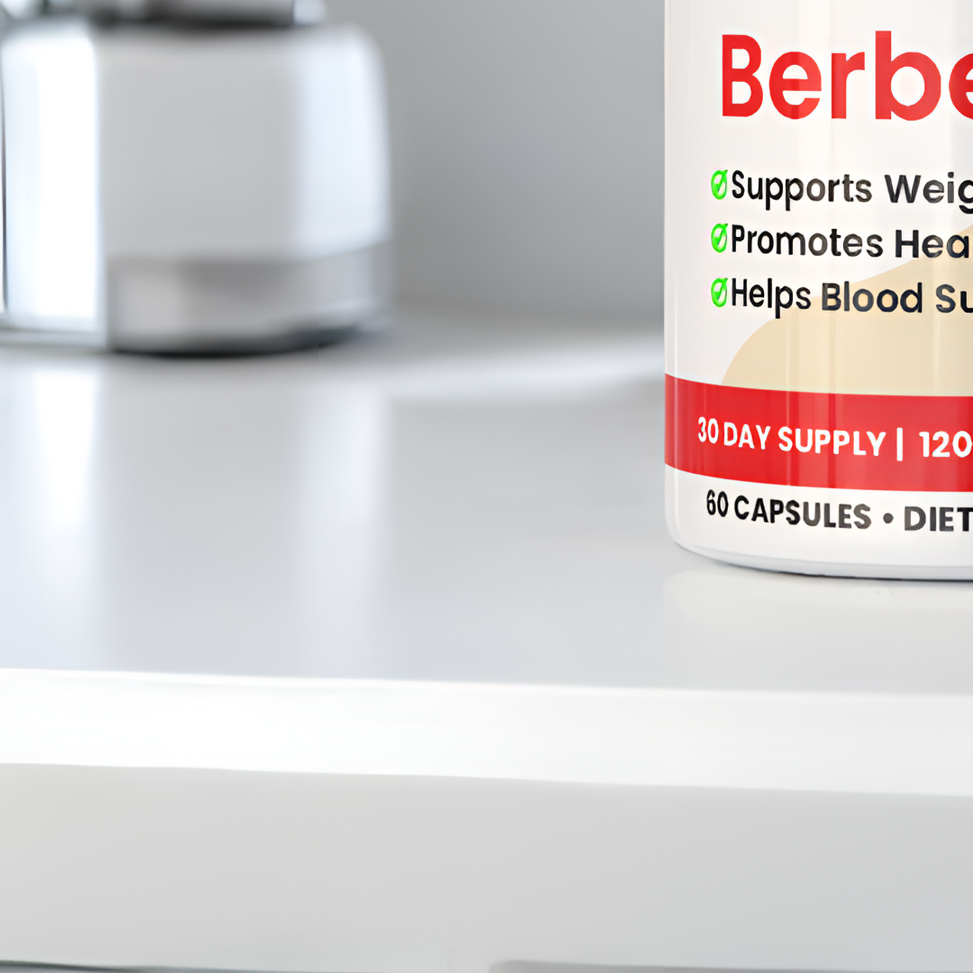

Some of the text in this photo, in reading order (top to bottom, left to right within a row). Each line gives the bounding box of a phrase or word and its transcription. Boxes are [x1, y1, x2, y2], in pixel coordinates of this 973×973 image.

[732, 170, 872, 211] Supports
[731, 225, 884, 257] Promotes
[731, 278, 812, 318] Helps
[821, 282, 923, 313] Blood
[698, 417, 719, 445] 30
[724, 422, 771, 451] DAY
[778, 427, 886, 457] SUPPLY
[706, 490, 729, 518] 60
[734, 495, 871, 529] CAPSULES
